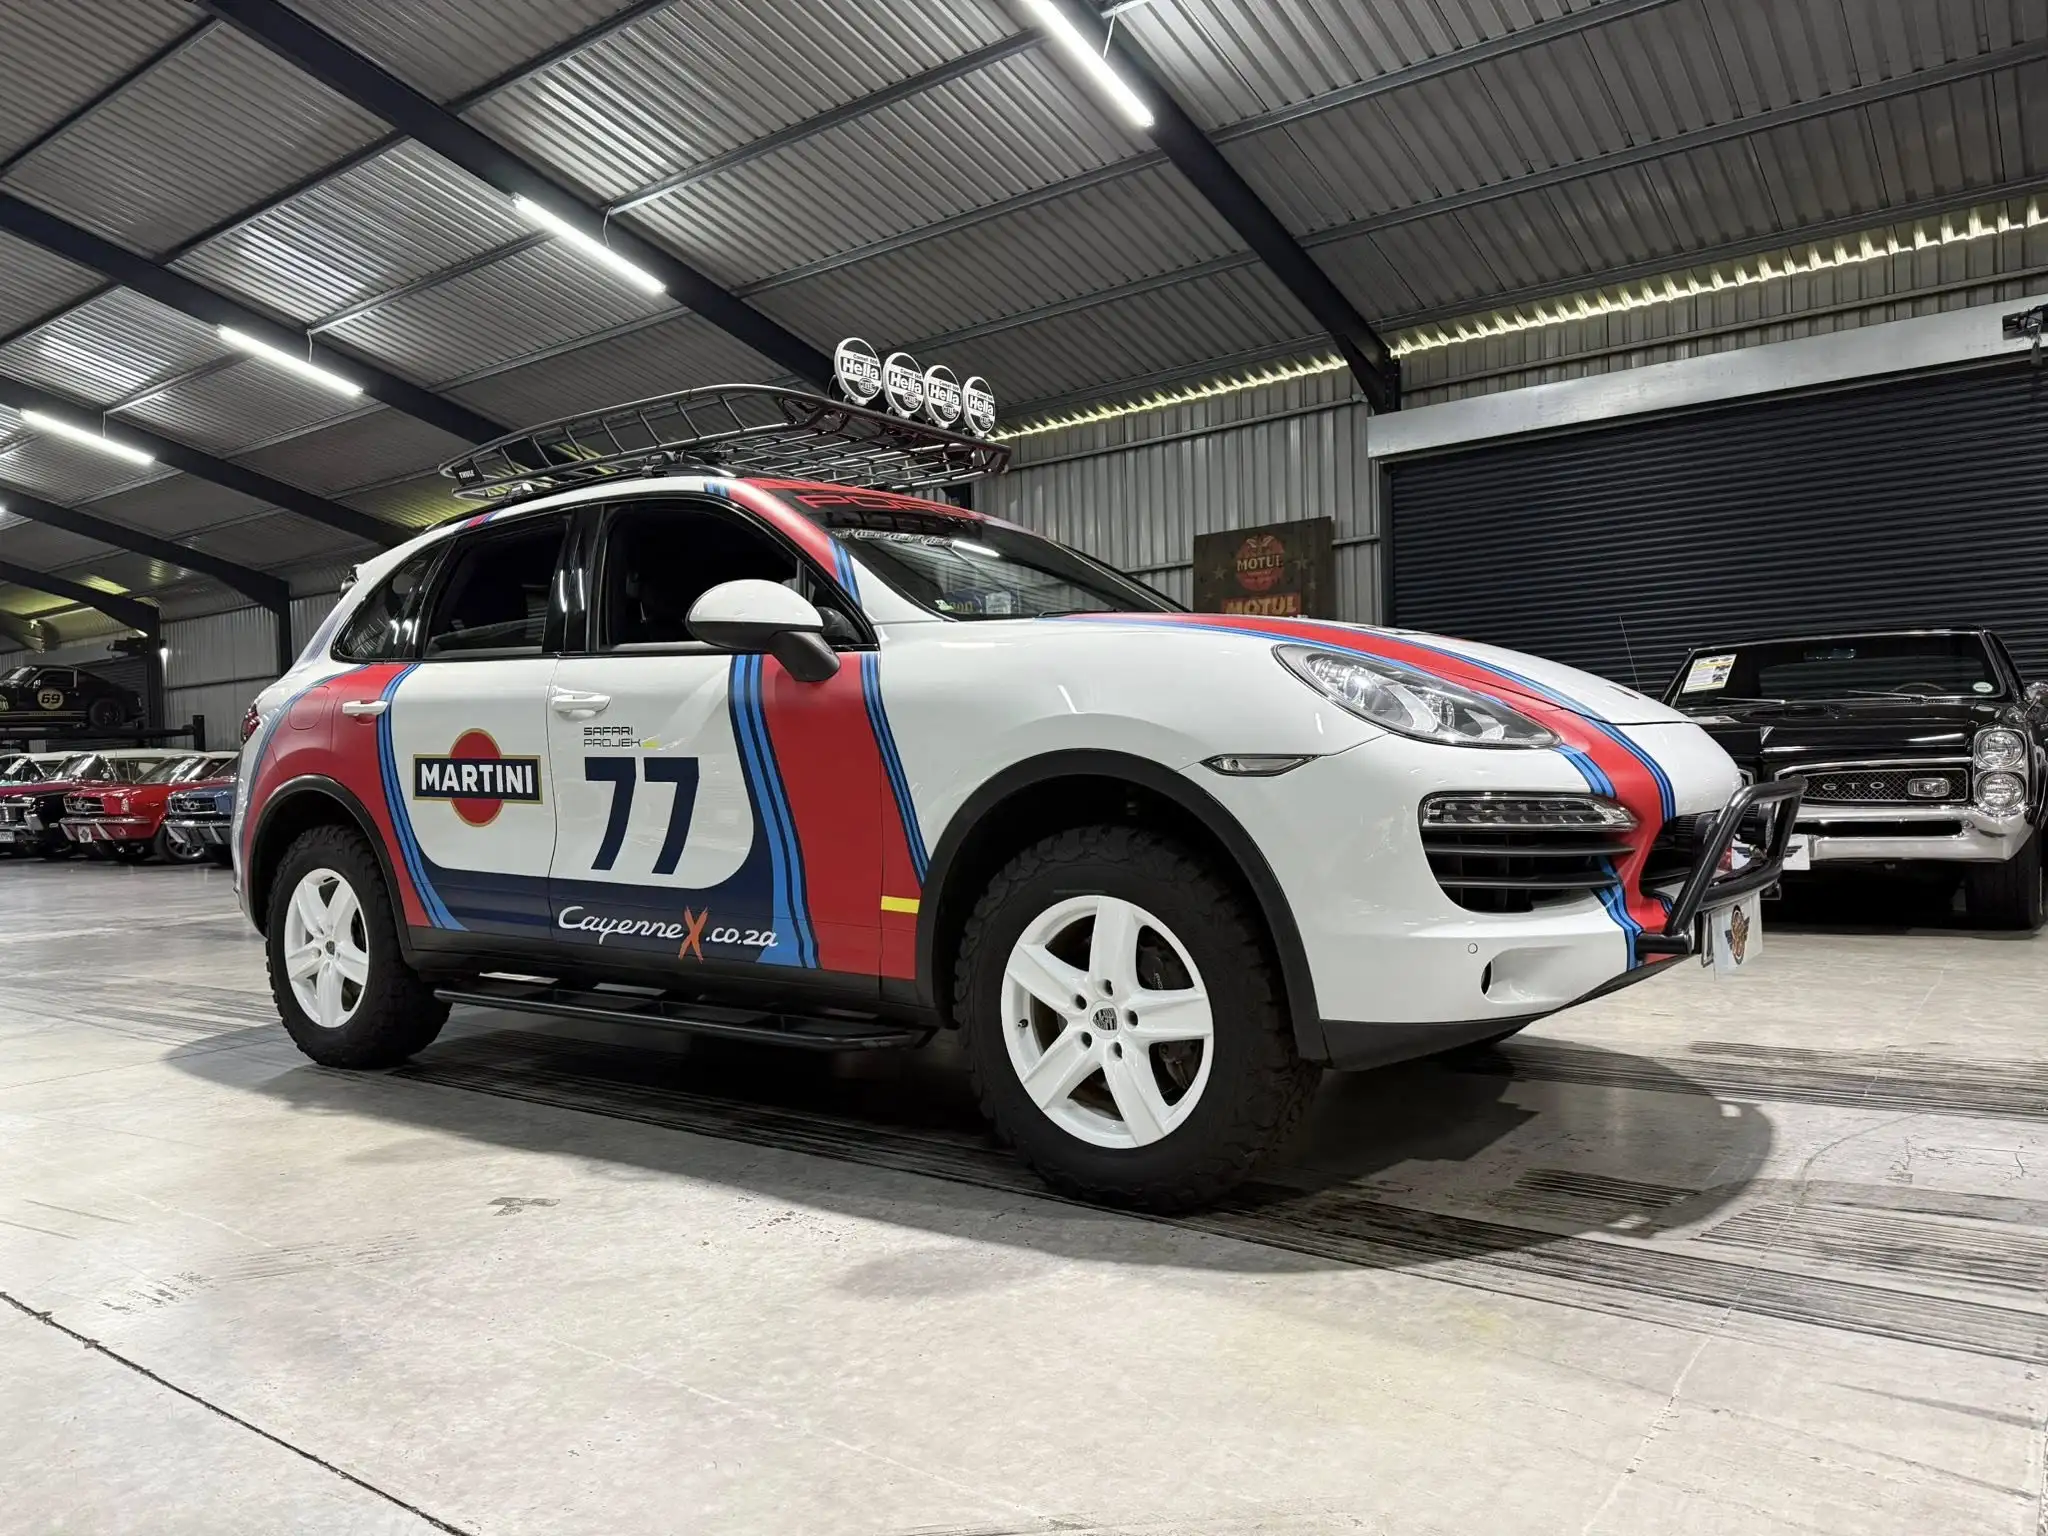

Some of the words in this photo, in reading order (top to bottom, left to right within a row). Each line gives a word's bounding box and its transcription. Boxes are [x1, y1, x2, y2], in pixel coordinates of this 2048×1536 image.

[842, 357, 879, 380] Hella
[890, 371, 922, 394] Hella
[930, 384, 960, 405] Hella
[969, 395, 994, 416] Hella
[1237, 554, 1284, 572] MOTUL
[1226, 596, 1297, 615] MOTUL
[42, 693, 60, 704] 69
[583, 726, 633, 736] SAFARI
[421, 763, 533, 794] MARTINI
[1822, 781, 1885, 791] GTO
[584, 756, 700, 875] 77
